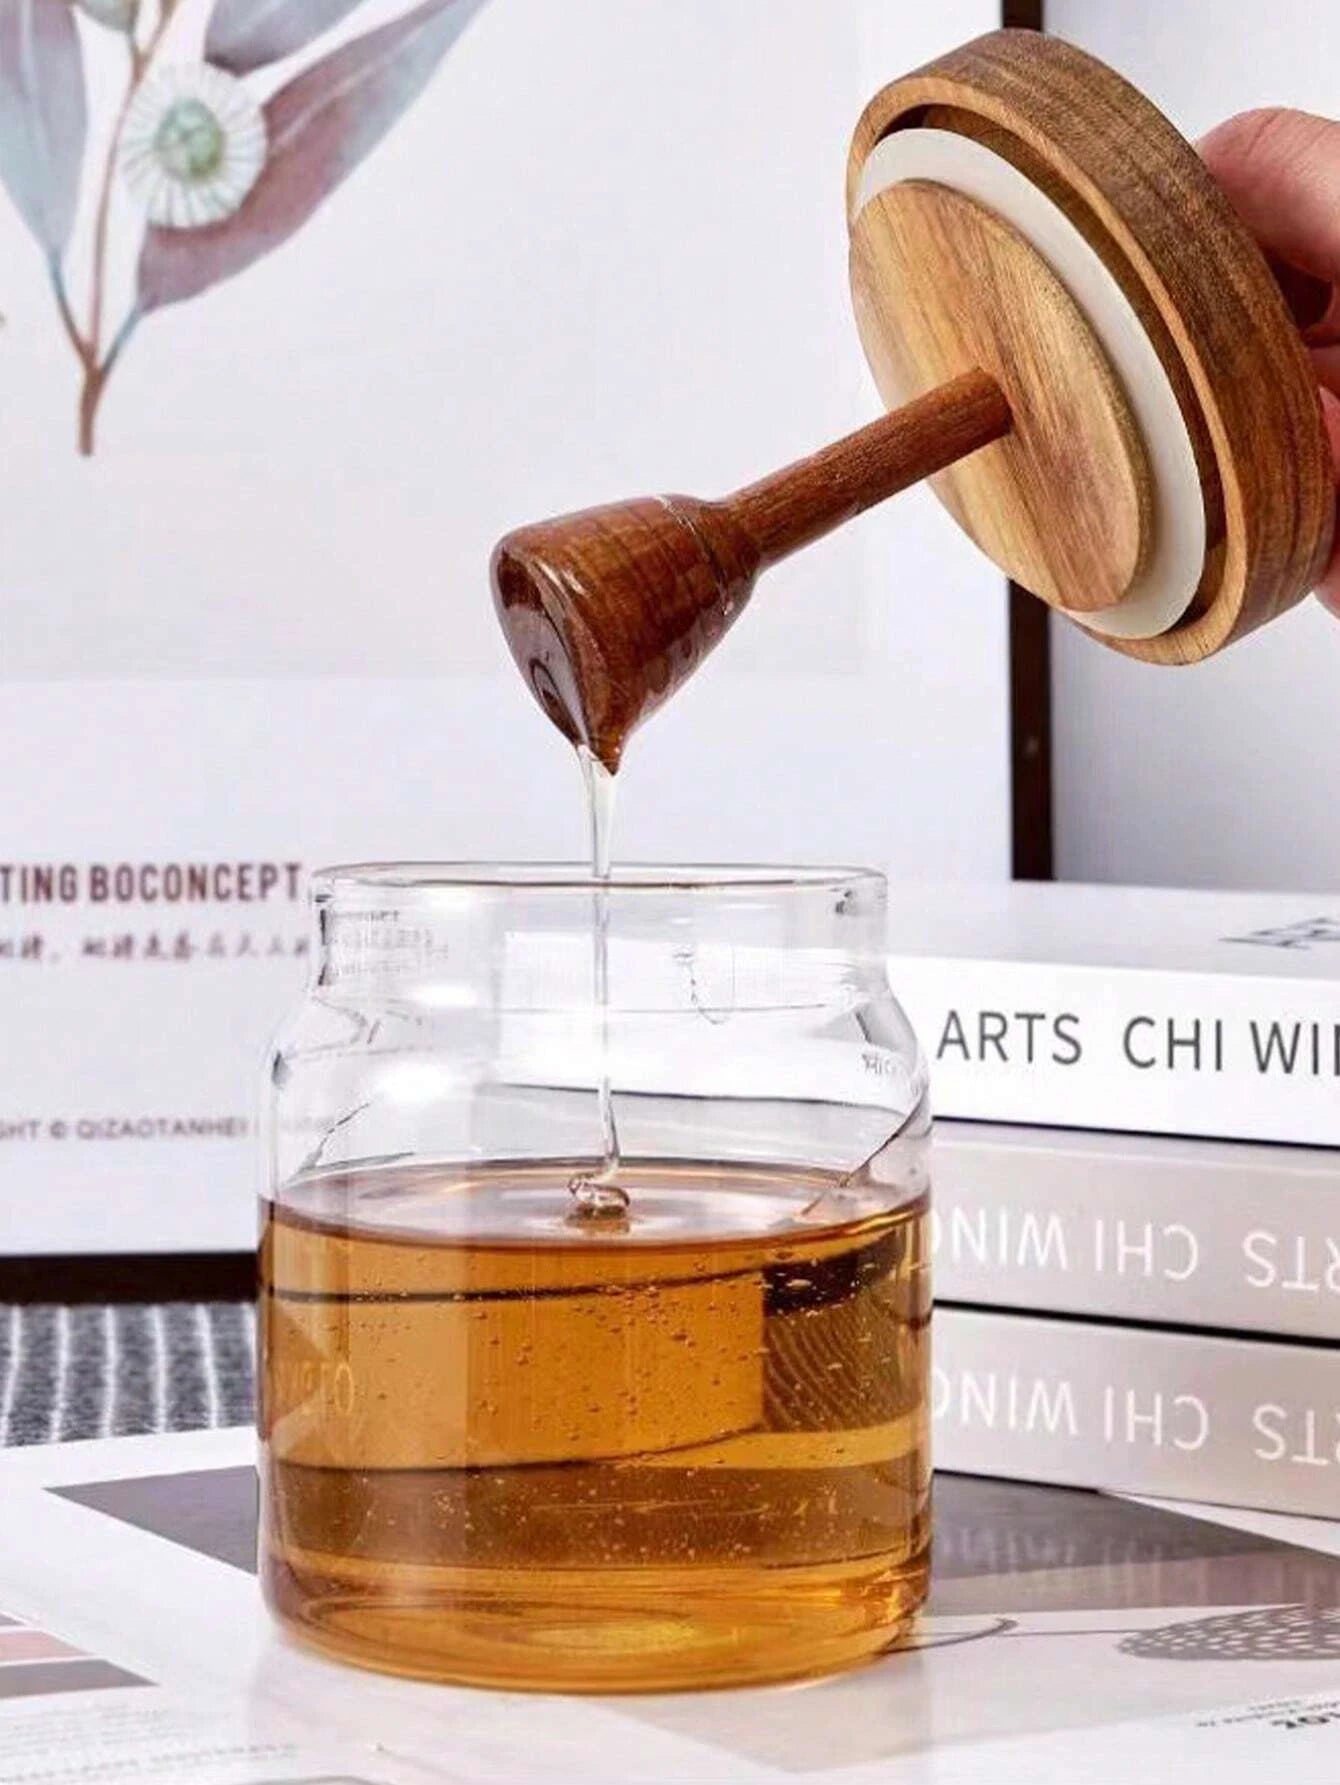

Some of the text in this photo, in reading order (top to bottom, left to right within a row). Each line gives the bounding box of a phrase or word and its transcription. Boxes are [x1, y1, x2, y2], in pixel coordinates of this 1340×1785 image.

[0, 861, 302, 905] TING BOCONCEPT
[936, 1009, 1083, 1066] ARTS
[1123, 1016, 1223, 1072] CHI
[1249, 1020, 1340, 1077] WI
[1095, 1219, 1199, 1281] CHI
[1103, 1385, 1210, 1451] CHI
[1251, 1402, 1340, 1467] TS
